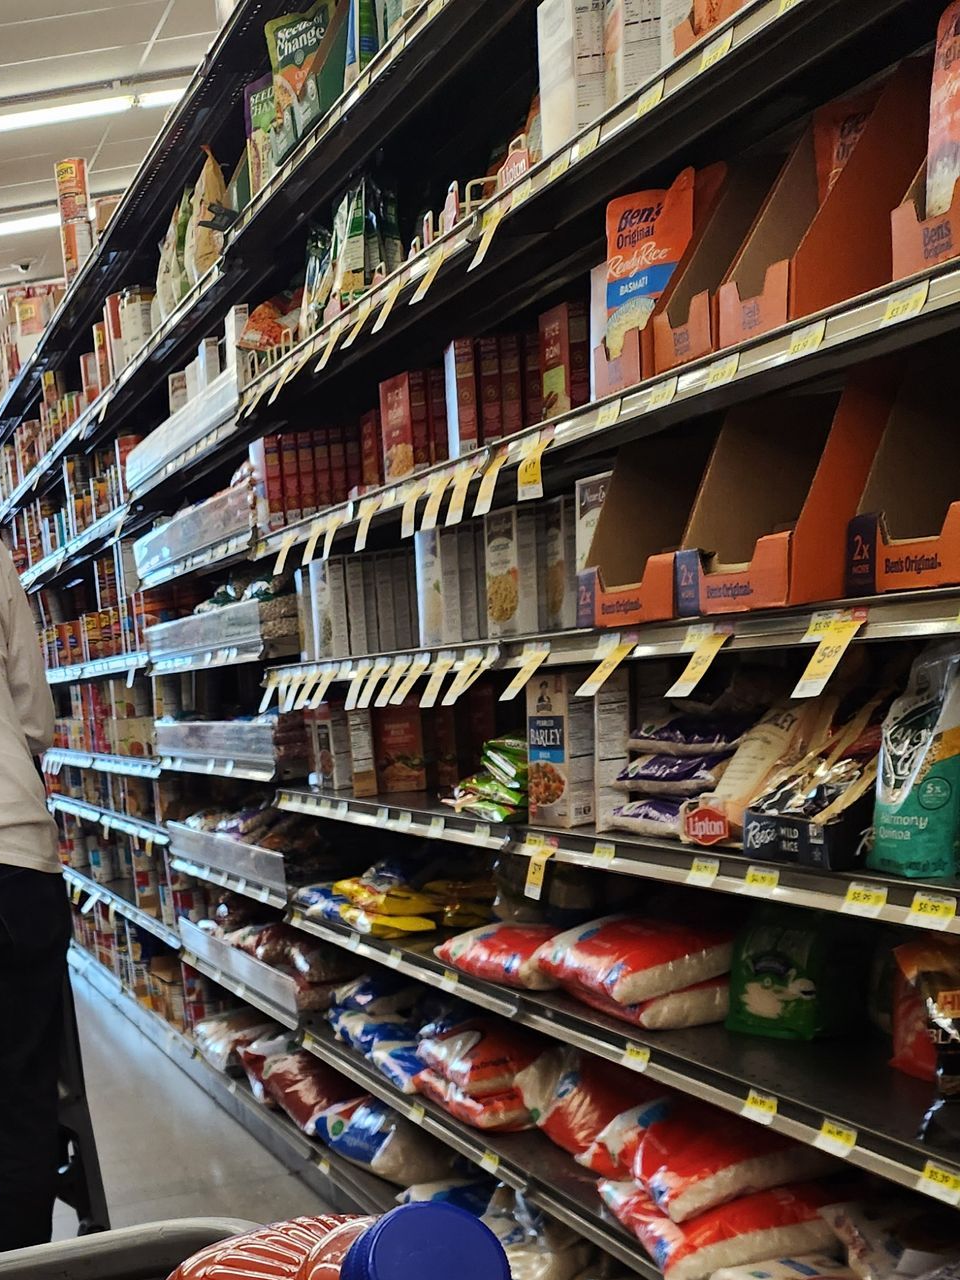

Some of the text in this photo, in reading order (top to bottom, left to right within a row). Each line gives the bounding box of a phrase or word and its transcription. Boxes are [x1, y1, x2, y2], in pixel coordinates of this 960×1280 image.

[277, 20, 312, 39] Seeds
[277, 27, 325, 61] Change
[251, 86, 274, 103] SEED
[617, 202, 664, 232] Ben's
[616, 223, 655, 250] Original
[619, 276, 648, 296] BASMATI
[852, 534, 870, 561] 2x
[884, 553, 938, 574] Ben's Original
[680, 564, 694, 586] 2x
[530, 728, 562, 747] BARLEY
[689, 816, 725, 839] Lipton
[880, 813, 928, 830] Harmony
[780, 827, 799, 839] WILD
[878, 826, 911, 840] Quinoa
[782, 840, 800, 852] RICE
